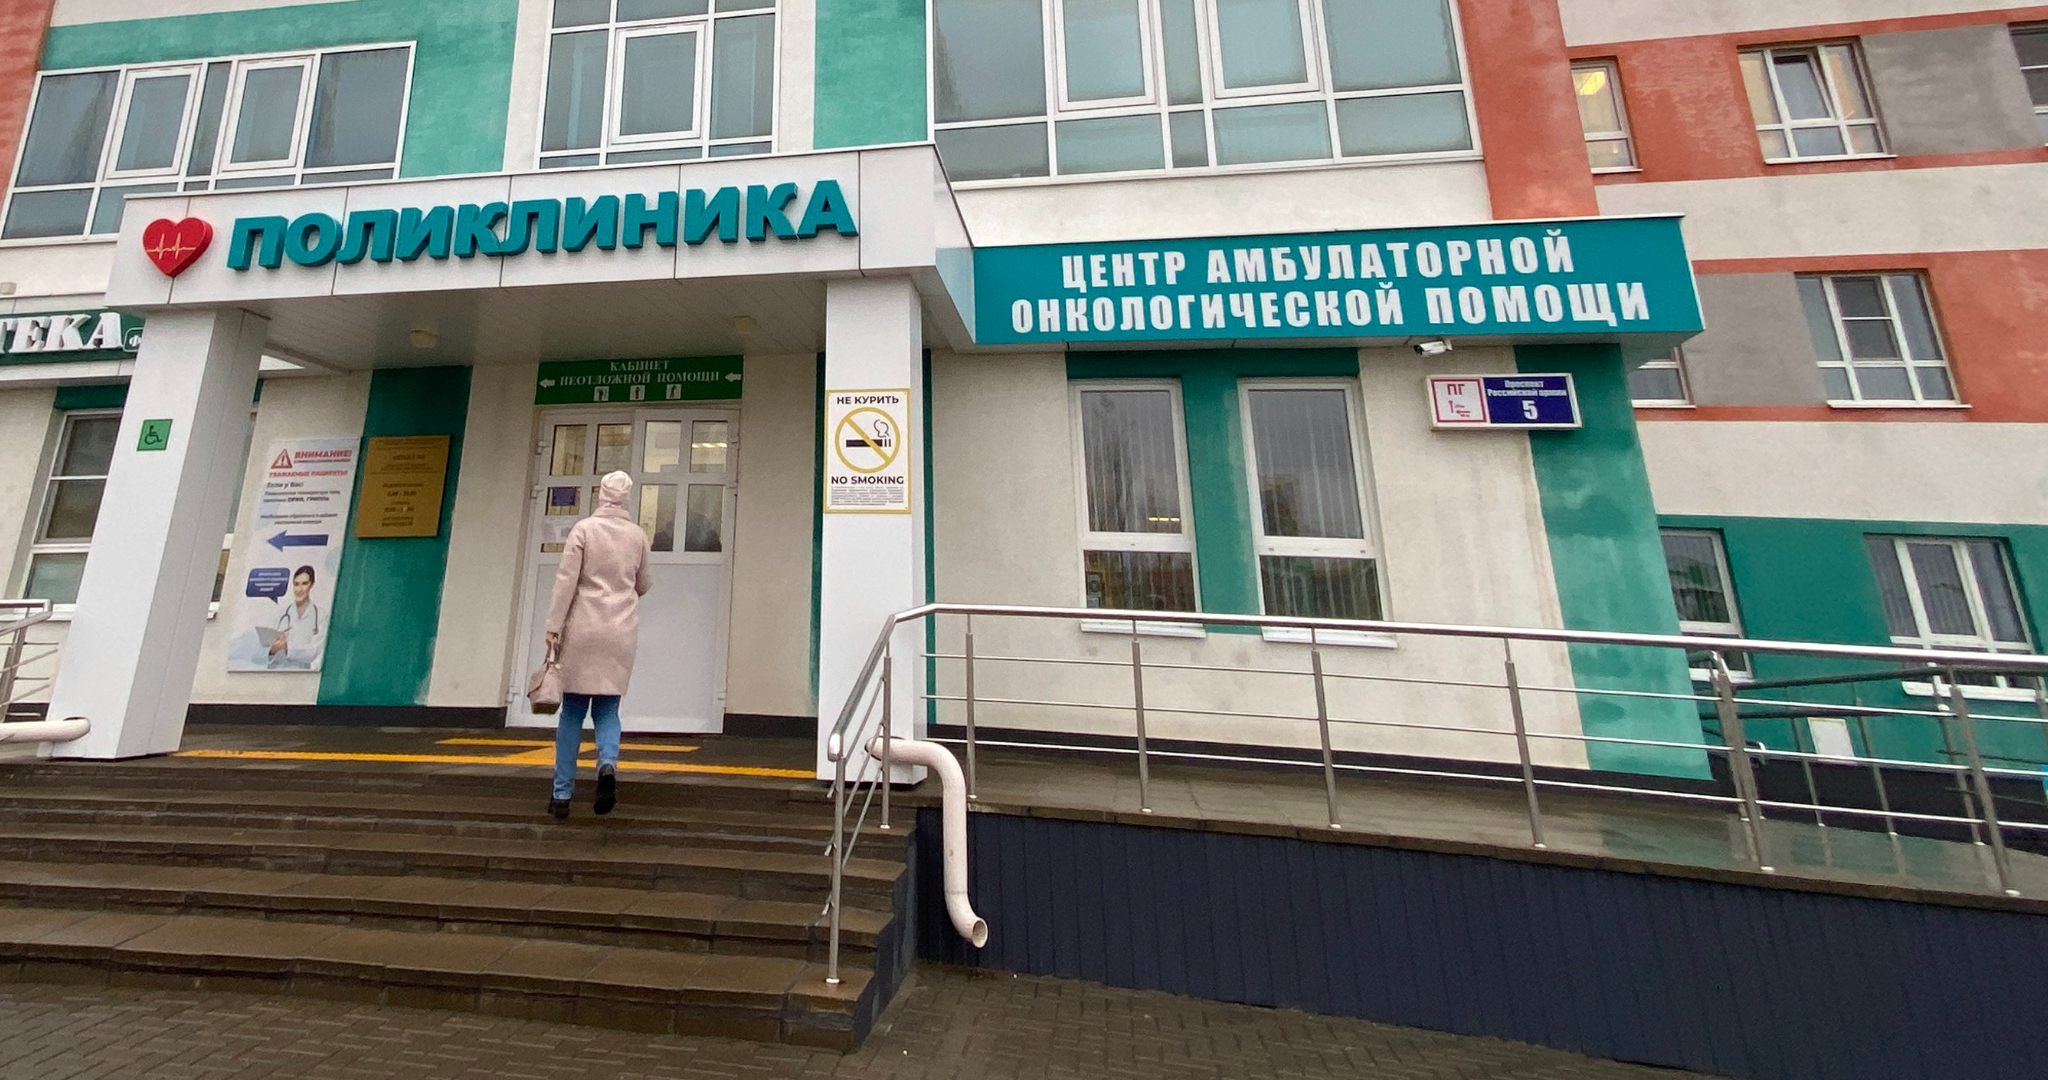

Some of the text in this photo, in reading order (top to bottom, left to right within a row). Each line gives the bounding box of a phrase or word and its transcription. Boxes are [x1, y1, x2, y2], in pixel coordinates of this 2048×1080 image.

[226, 179, 858, 272] ПОЛИКЛИНИКА
[1061, 228, 1575, 293] ЦЕНТР АМБУЛАТОРНОЙ
[1010, 281, 1651, 334] ОНКОЛОГИЧЕСКОЙ ПОМОЩИ
[610, 360, 671, 372] КАБИНЕТ
[560, 371, 720, 386] НЕОТЛОЖНОЙ ПОМОЩИ
[1447, 383, 1465, 395] ПГ
[837, 395, 900, 405] НЕ КУРИТЬ
[1522, 400, 1538, 420] 5
[294, 449, 353, 459] ВНИМАНИЕ!
[831, 476, 904, 485] NO SMOKING
